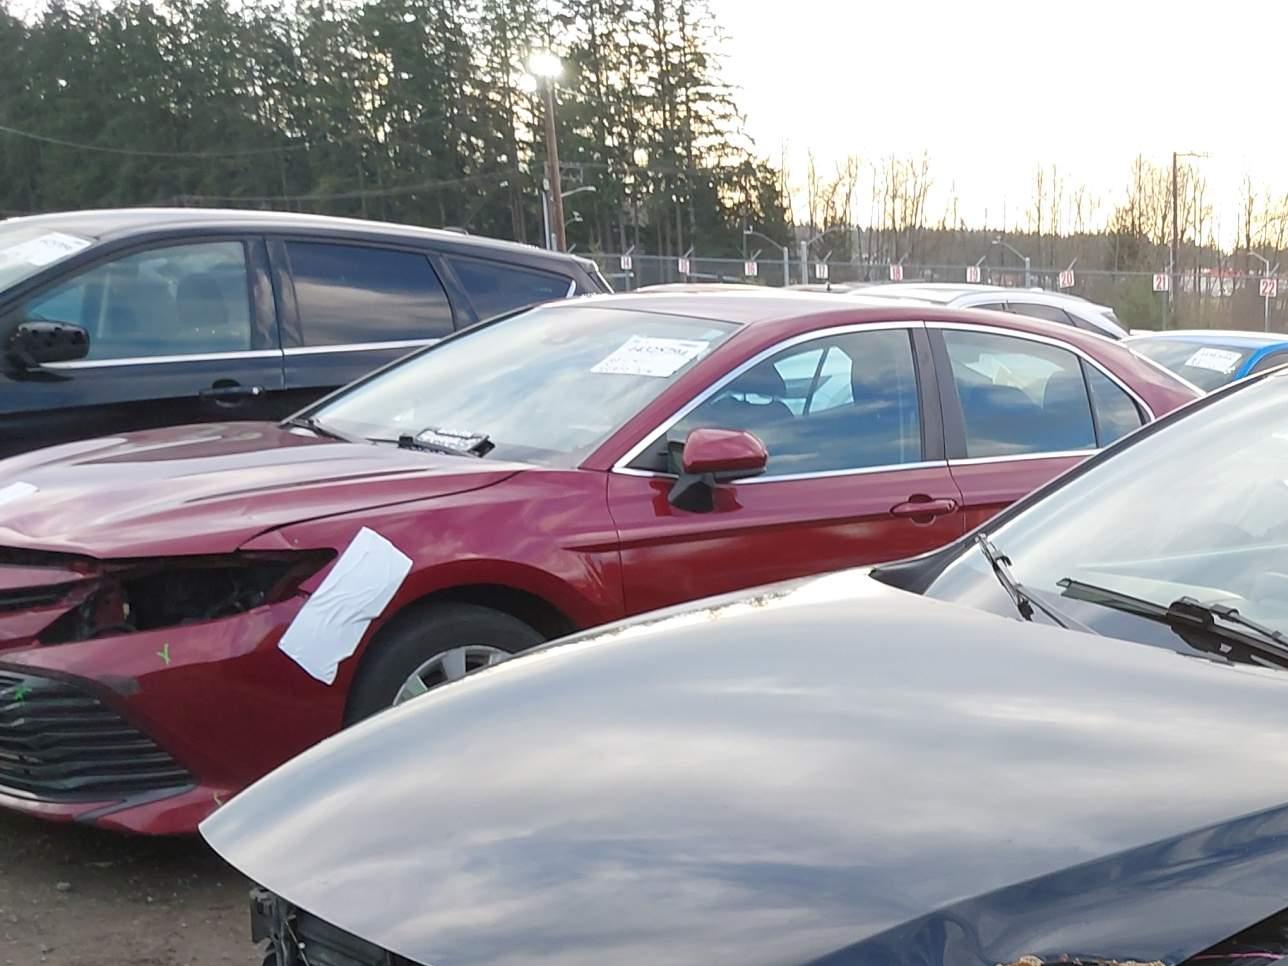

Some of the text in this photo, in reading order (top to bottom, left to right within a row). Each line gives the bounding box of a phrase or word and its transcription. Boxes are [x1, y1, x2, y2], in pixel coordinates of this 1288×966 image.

[1061, 271, 1073, 287] 20
[1157, 274, 1168, 290] 21
[1262, 279, 1275, 295] 22
